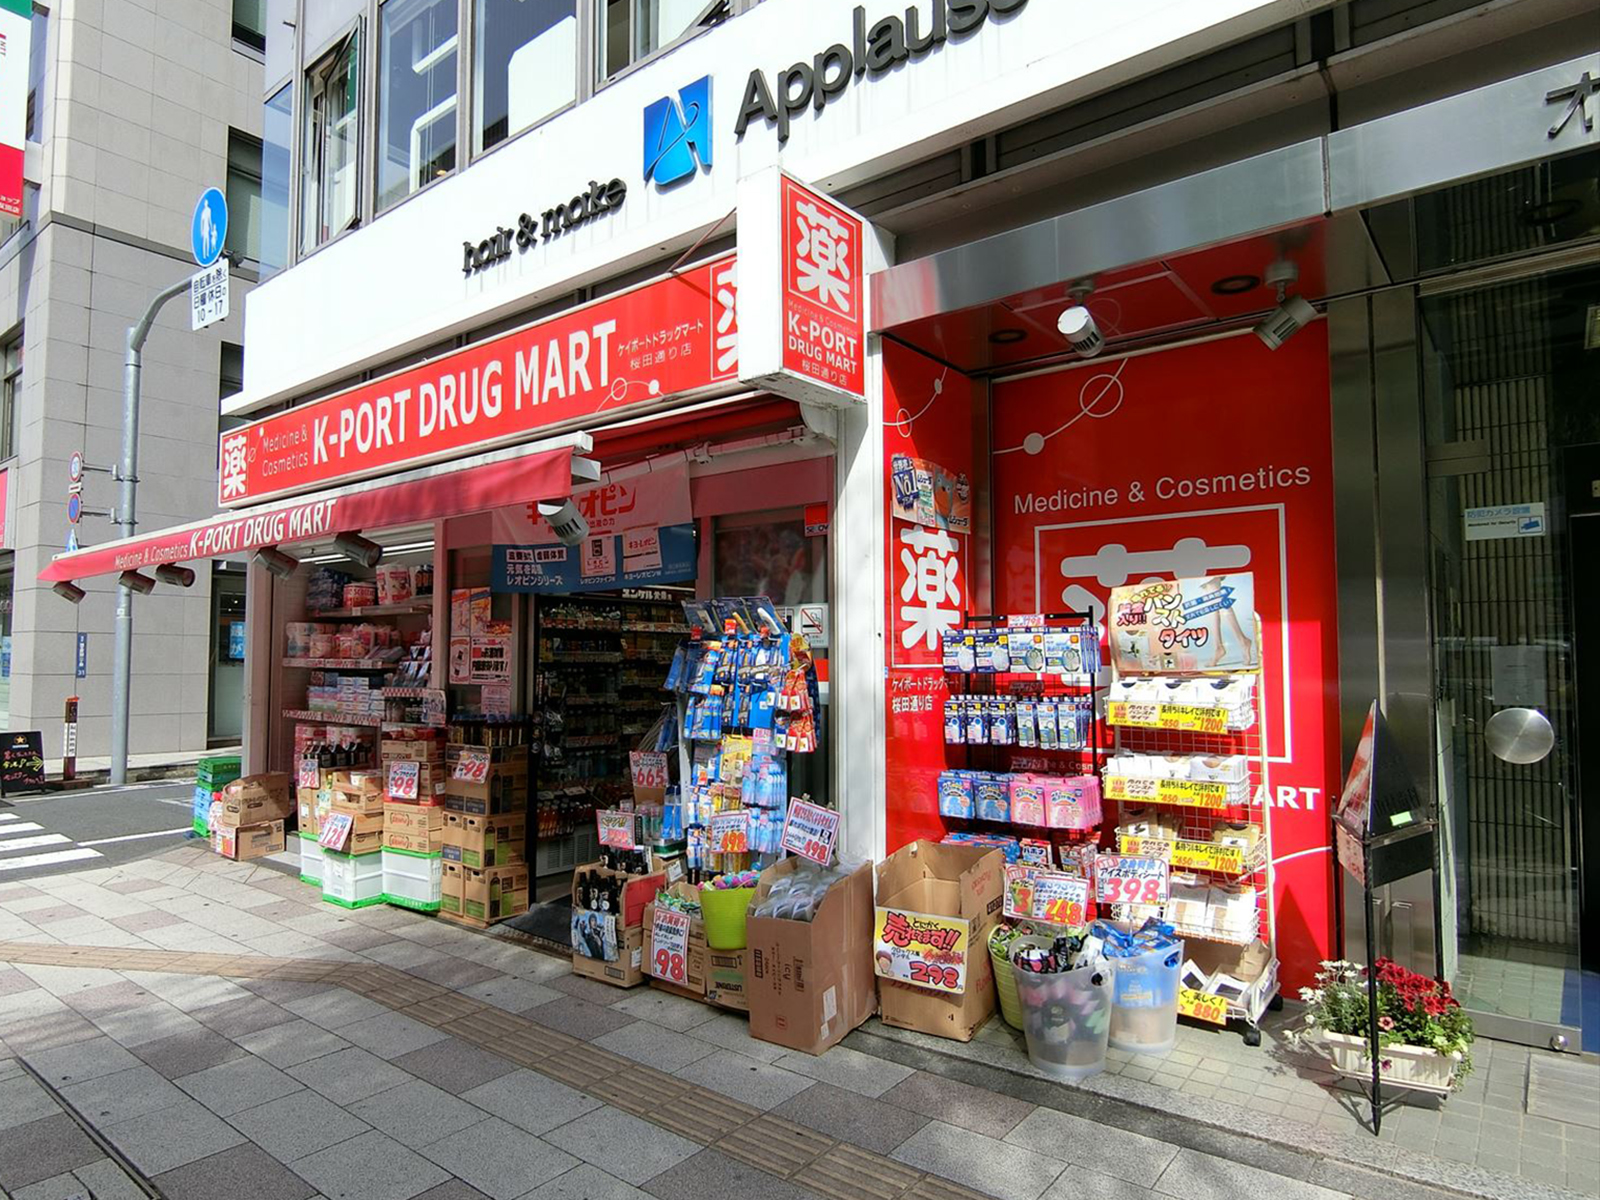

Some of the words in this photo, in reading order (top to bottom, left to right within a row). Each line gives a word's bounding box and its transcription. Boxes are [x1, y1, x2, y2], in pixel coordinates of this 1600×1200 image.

[735, 0, 1028, 142] Applaus
[463, 226, 515, 273] hair
[517, 213, 538, 247] &
[541, 176, 628, 239] make
[796, 200, 850, 313] 薬
[197, 299, 223, 323] 10-17
[788, 299, 818, 321] Medicine
[617, 318, 704, 356] ケイポートドラッグマート
[788, 311, 857, 359] K-PORT
[630, 344, 692, 371] 桜田通り店
[788, 335, 822, 361] DRUG
[826, 352, 857, 375] MART
[801, 359, 848, 386] 桜田通り店
[313, 388, 412, 466] K-PORT
[419, 360, 502, 439] DRUG
[514, 318, 617, 412] MART
[262, 429, 300, 454] Medicine
[301, 424, 308, 441] &
[223, 435, 247, 498] 薬
[262, 451, 309, 478] Cosmetics
[1013, 487, 1118, 514] Medicine
[1128, 480, 1147, 503] &
[1155, 465, 1313, 499] Cosmetics
[114, 551, 143, 569] Medicine
[143, 550, 149, 562] &
[151, 541, 188, 562] Cosmetics
[189, 521, 244, 558] K-PORT
[243, 511, 286, 547] DRUG
[288, 498, 337, 536] MART
[506, 575, 564, 586] レオピンシリーズ
[900, 524, 960, 651] 薬
[1158, 627, 1209, 650] タイツ
[1199, 717, 1223, 732] 1200
[301, 771, 316, 787] 98
[464, 760, 487, 778] 98
[394, 777, 415, 795] 98
[1199, 792, 1222, 807] 1200
[1252, 787, 1321, 810] ART
[322, 827, 345, 846] 128
[1214, 855, 1238, 872] 1200
[1104, 878, 1160, 903] 398
[913, 918, 939, 930] とにかく
[1044, 897, 1083, 926] 248
[882, 911, 961, 953] 売れてます!!
[656, 947, 684, 981] 98
[909, 960, 960, 989] 298
[1192, 1003, 1221, 1022] 880
